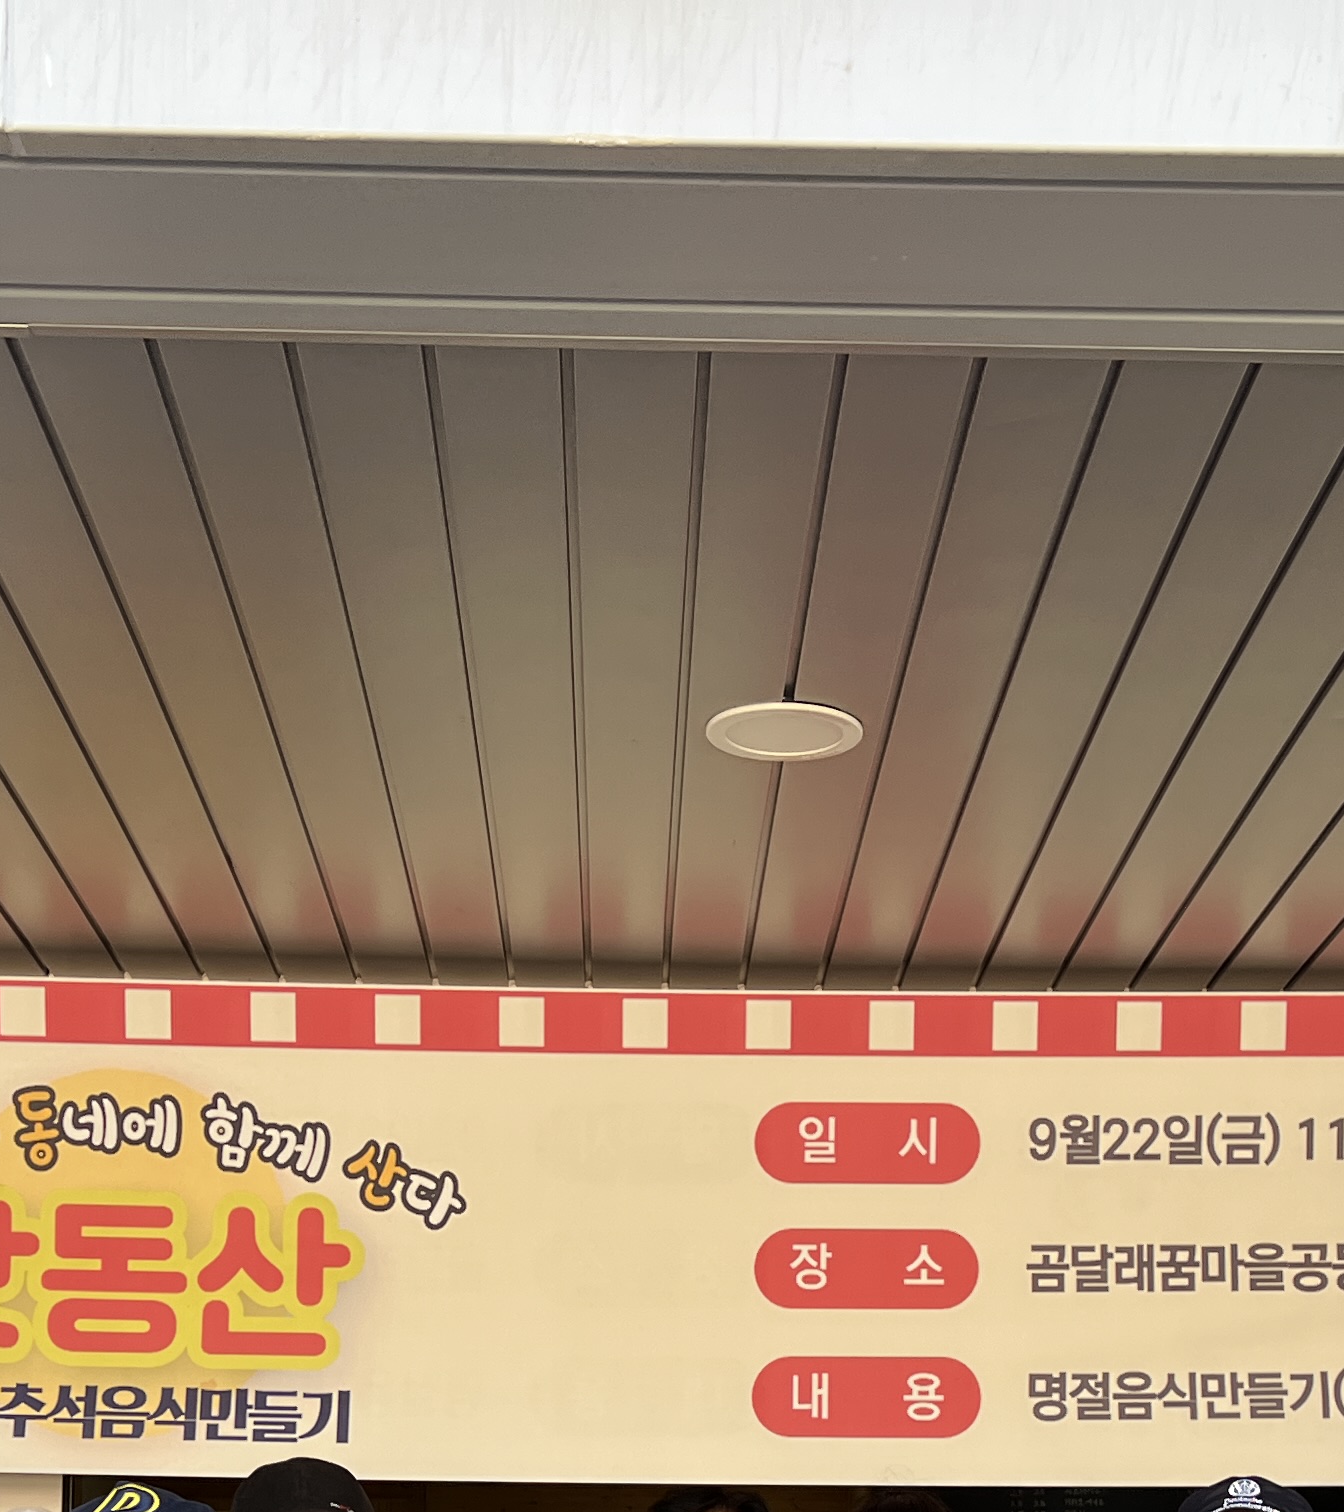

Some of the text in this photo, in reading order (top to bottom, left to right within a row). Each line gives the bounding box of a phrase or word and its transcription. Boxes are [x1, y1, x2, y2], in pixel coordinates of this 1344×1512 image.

[13, 1085, 182, 1172] 동네에
[202, 1093, 331, 1183] 함께
[345, 1141, 467, 1230] 산다
[796, 1114, 939, 1165] 일 시
[1027, 1113, 1281, 1168] 9월22일(금)
[788, 1242, 947, 1291] 장 소
[790, 1370, 946, 1423] 내 용
